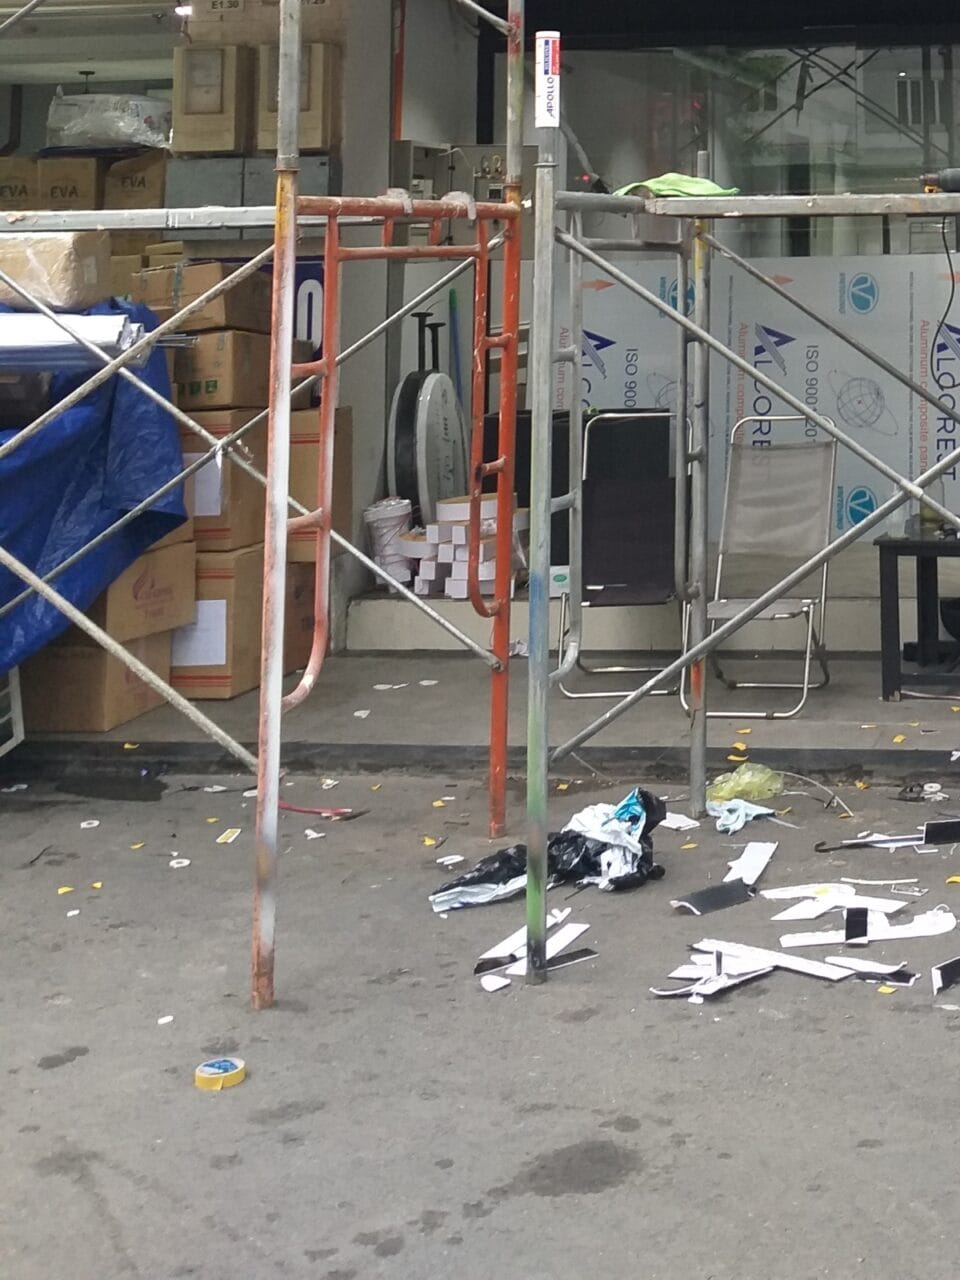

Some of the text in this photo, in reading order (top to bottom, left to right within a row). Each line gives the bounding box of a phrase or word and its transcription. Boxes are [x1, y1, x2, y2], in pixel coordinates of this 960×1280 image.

[625, 348, 639, 376] ISO
[805, 344, 819, 373] ISO
[918, 319, 931, 379] Aluminum
